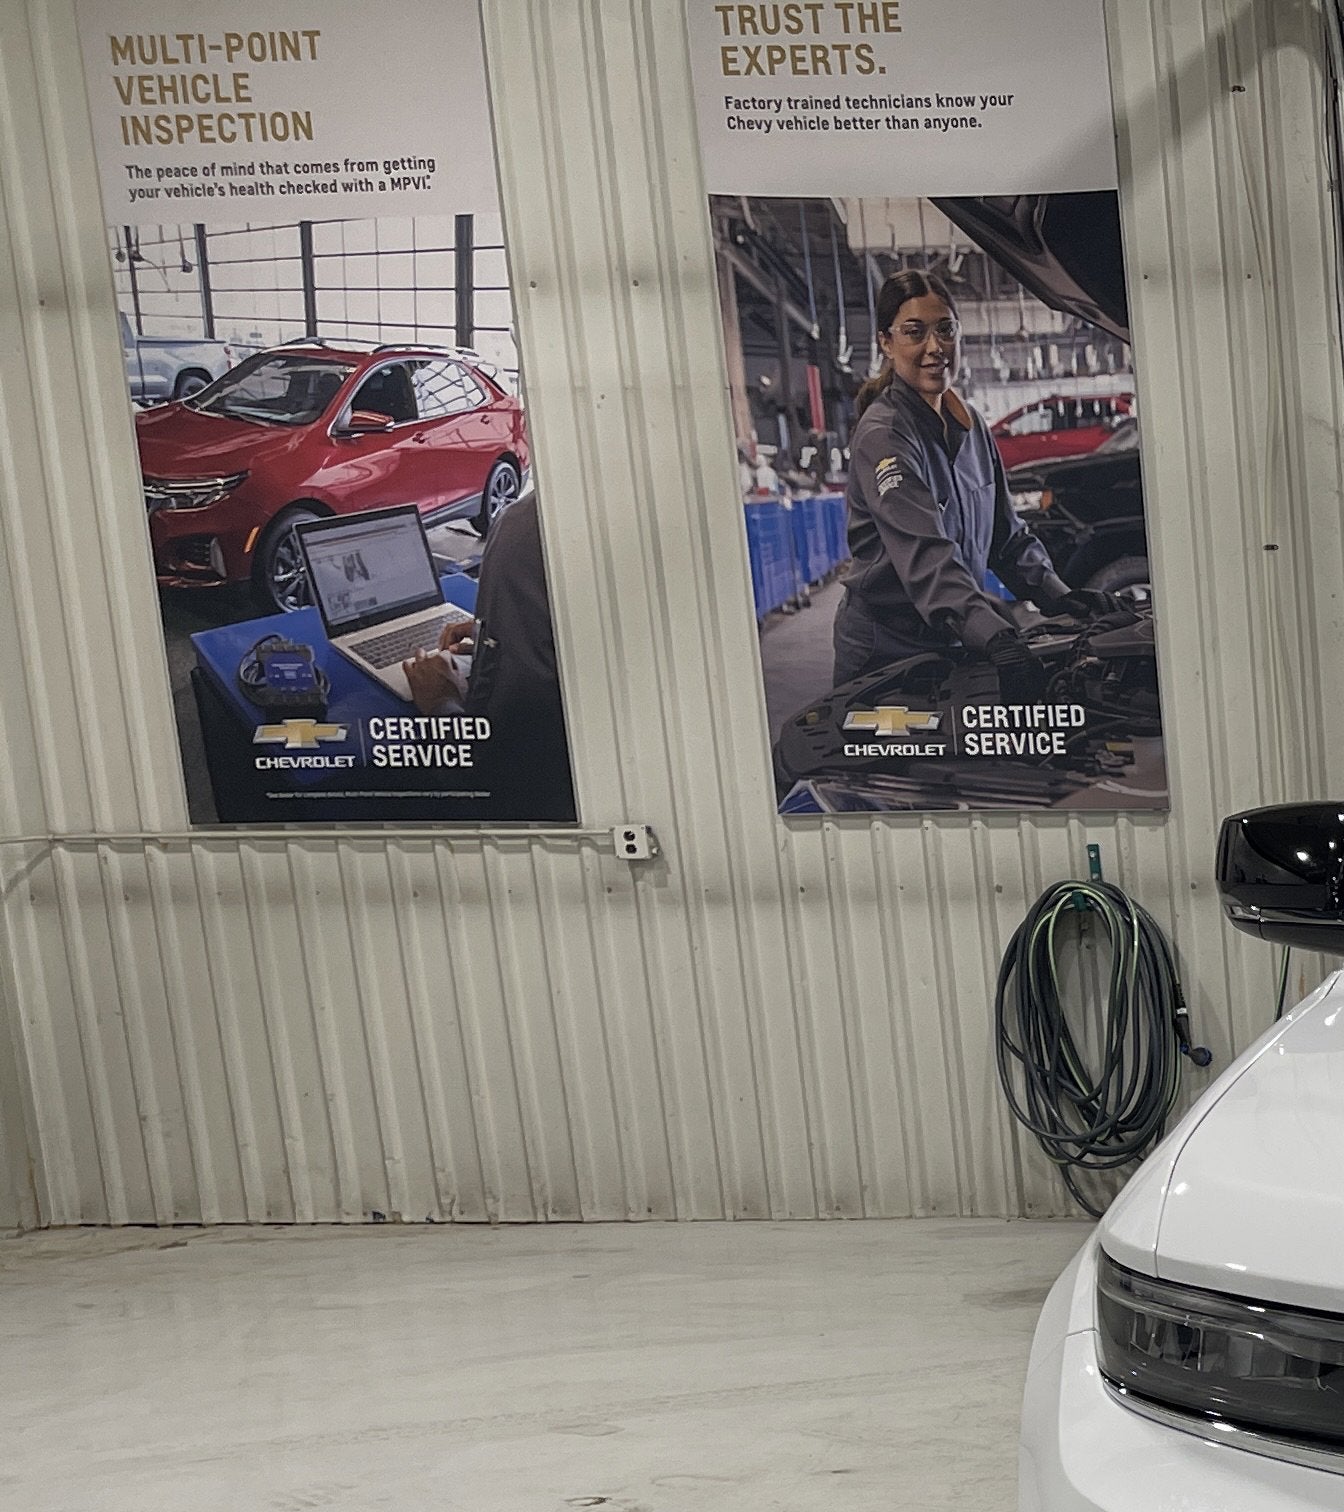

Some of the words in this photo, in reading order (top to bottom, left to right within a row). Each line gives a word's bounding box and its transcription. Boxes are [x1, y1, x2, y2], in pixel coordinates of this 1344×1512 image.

[714, 3, 825, 36] TRUST
[834, 1, 902, 34] THE
[109, 29, 322, 66] MULTI-POINT
[720, 43, 887, 77] EXPERTS.
[113, 72, 253, 106] VEHICLE
[724, 96, 782, 113] Factory
[786, 95, 841, 110] trained
[845, 94, 932, 109] technicians
[935, 93, 976, 108] know
[979, 94, 1015, 111] your
[120, 110, 315, 146] INSPECTION
[727, 115, 773, 134] Chevy
[776, 115, 830, 131] vehicle
[833, 115, 881, 130] better
[885, 115, 920, 130] than
[923, 115, 983, 133] anyone.
[125, 164, 153, 179] The
[156, 165, 198, 182] peace
[202, 162, 217, 177] of
[220, 161, 256, 177] mind
[259, 160, 290, 176] that
[293, 161, 341, 175] comes
[344, 158, 379, 173] from
[383, 155, 436, 175] getting
[129, 187, 161, 203] your
[164, 181, 226, 199] vehicle's
[229, 181, 275, 197] health
[279, 178, 338, 196] checked
[341, 177, 374, 193] with
[378, 180, 387, 192] a
[368, 717, 491, 741] CERTIFIED
[962, 704, 1086, 729] CERTIFIED
[372, 744, 474, 768] SERVICE
[843, 743, 947, 757] CHEVROLET
[964, 732, 1068, 756] SERVICE
[254, 755, 356, 770] CHEVROLET
